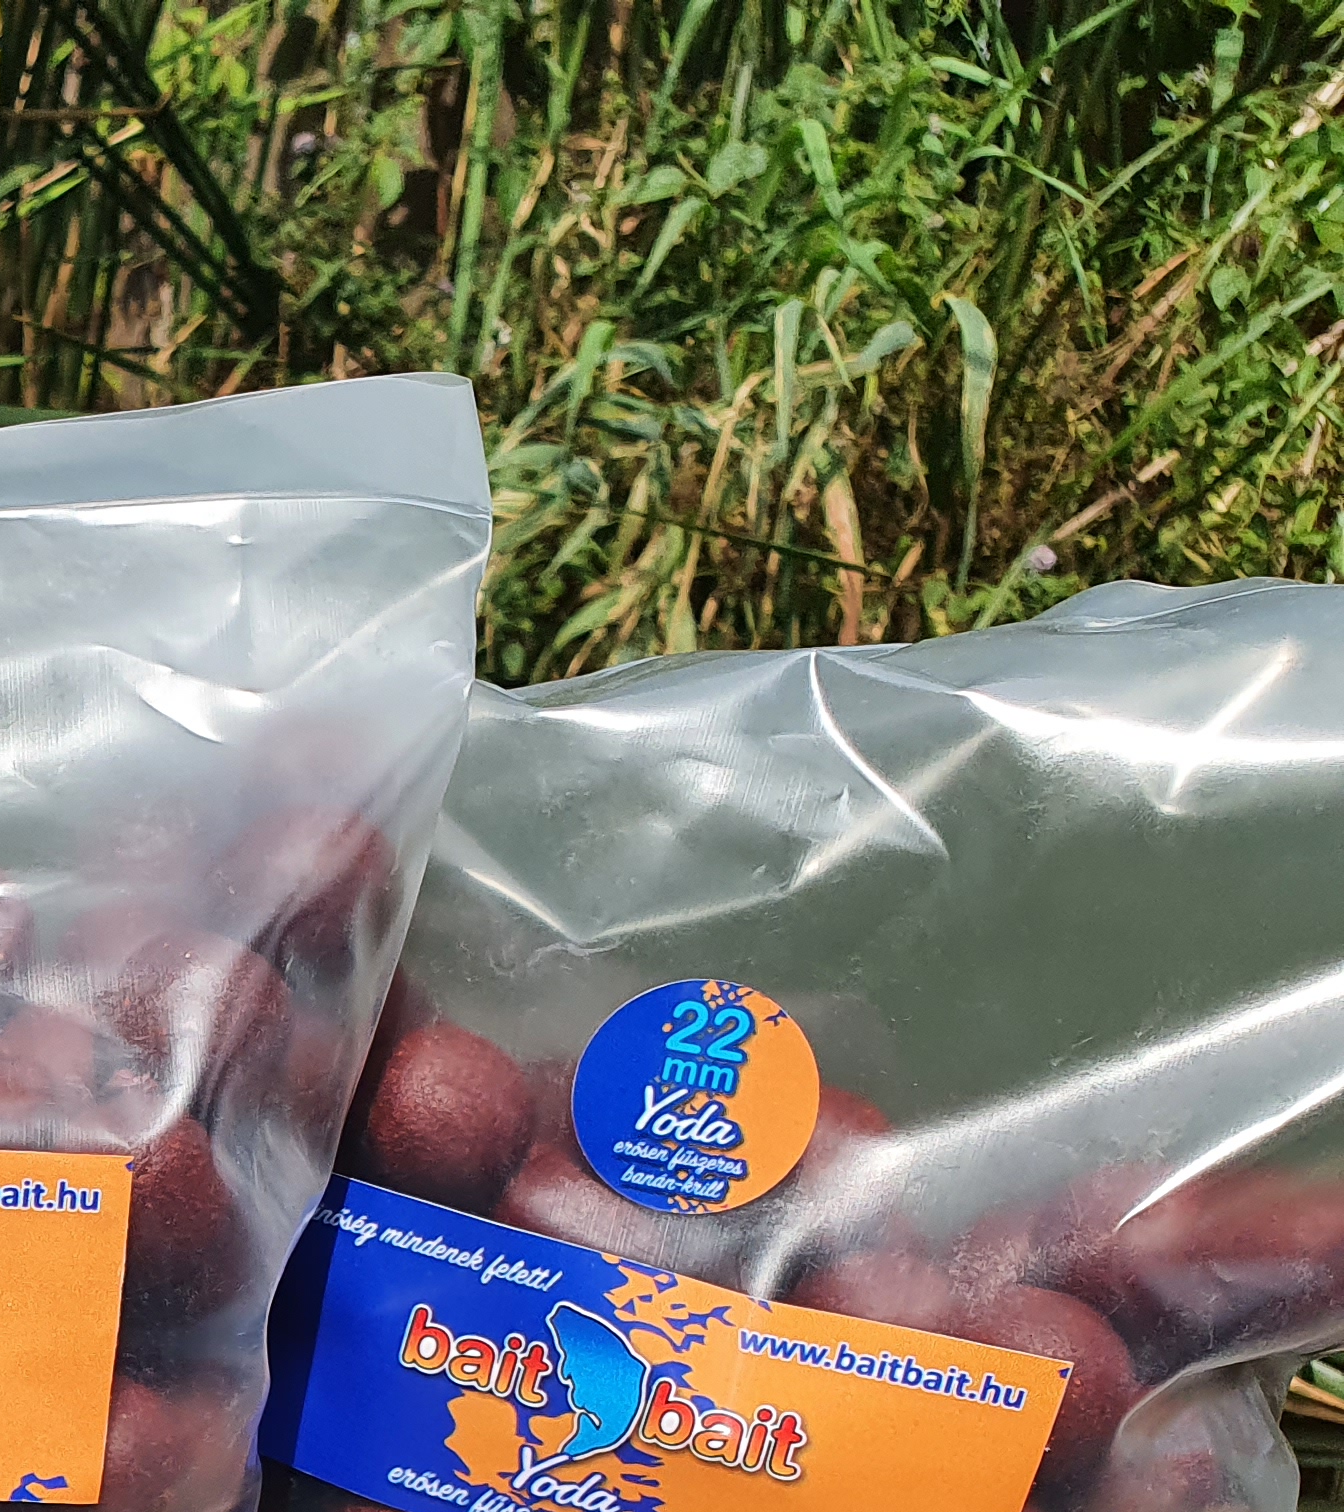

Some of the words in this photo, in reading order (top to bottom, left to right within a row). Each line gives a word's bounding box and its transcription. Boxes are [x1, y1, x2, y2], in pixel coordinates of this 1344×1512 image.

[666, 1000, 750, 1062] 22
[662, 1057, 734, 1091] mm
[635, 1085, 736, 1145] Yoda
[614, 1140, 668, 1162] erősen
[668, 1146, 743, 1175] fűszeres
[621, 1165, 725, 1199] banán-krill
[312, 1205, 376, 1247] inőség
[379, 1226, 483, 1272] mindenek
[482, 1255, 563, 1292] felett!
[400, 1303, 553, 1407] bait
[639, 1379, 808, 1481] bait
[739, 1328, 1026, 1411] www.baitbait.hu
[387, 1466, 470, 1506] erősen
